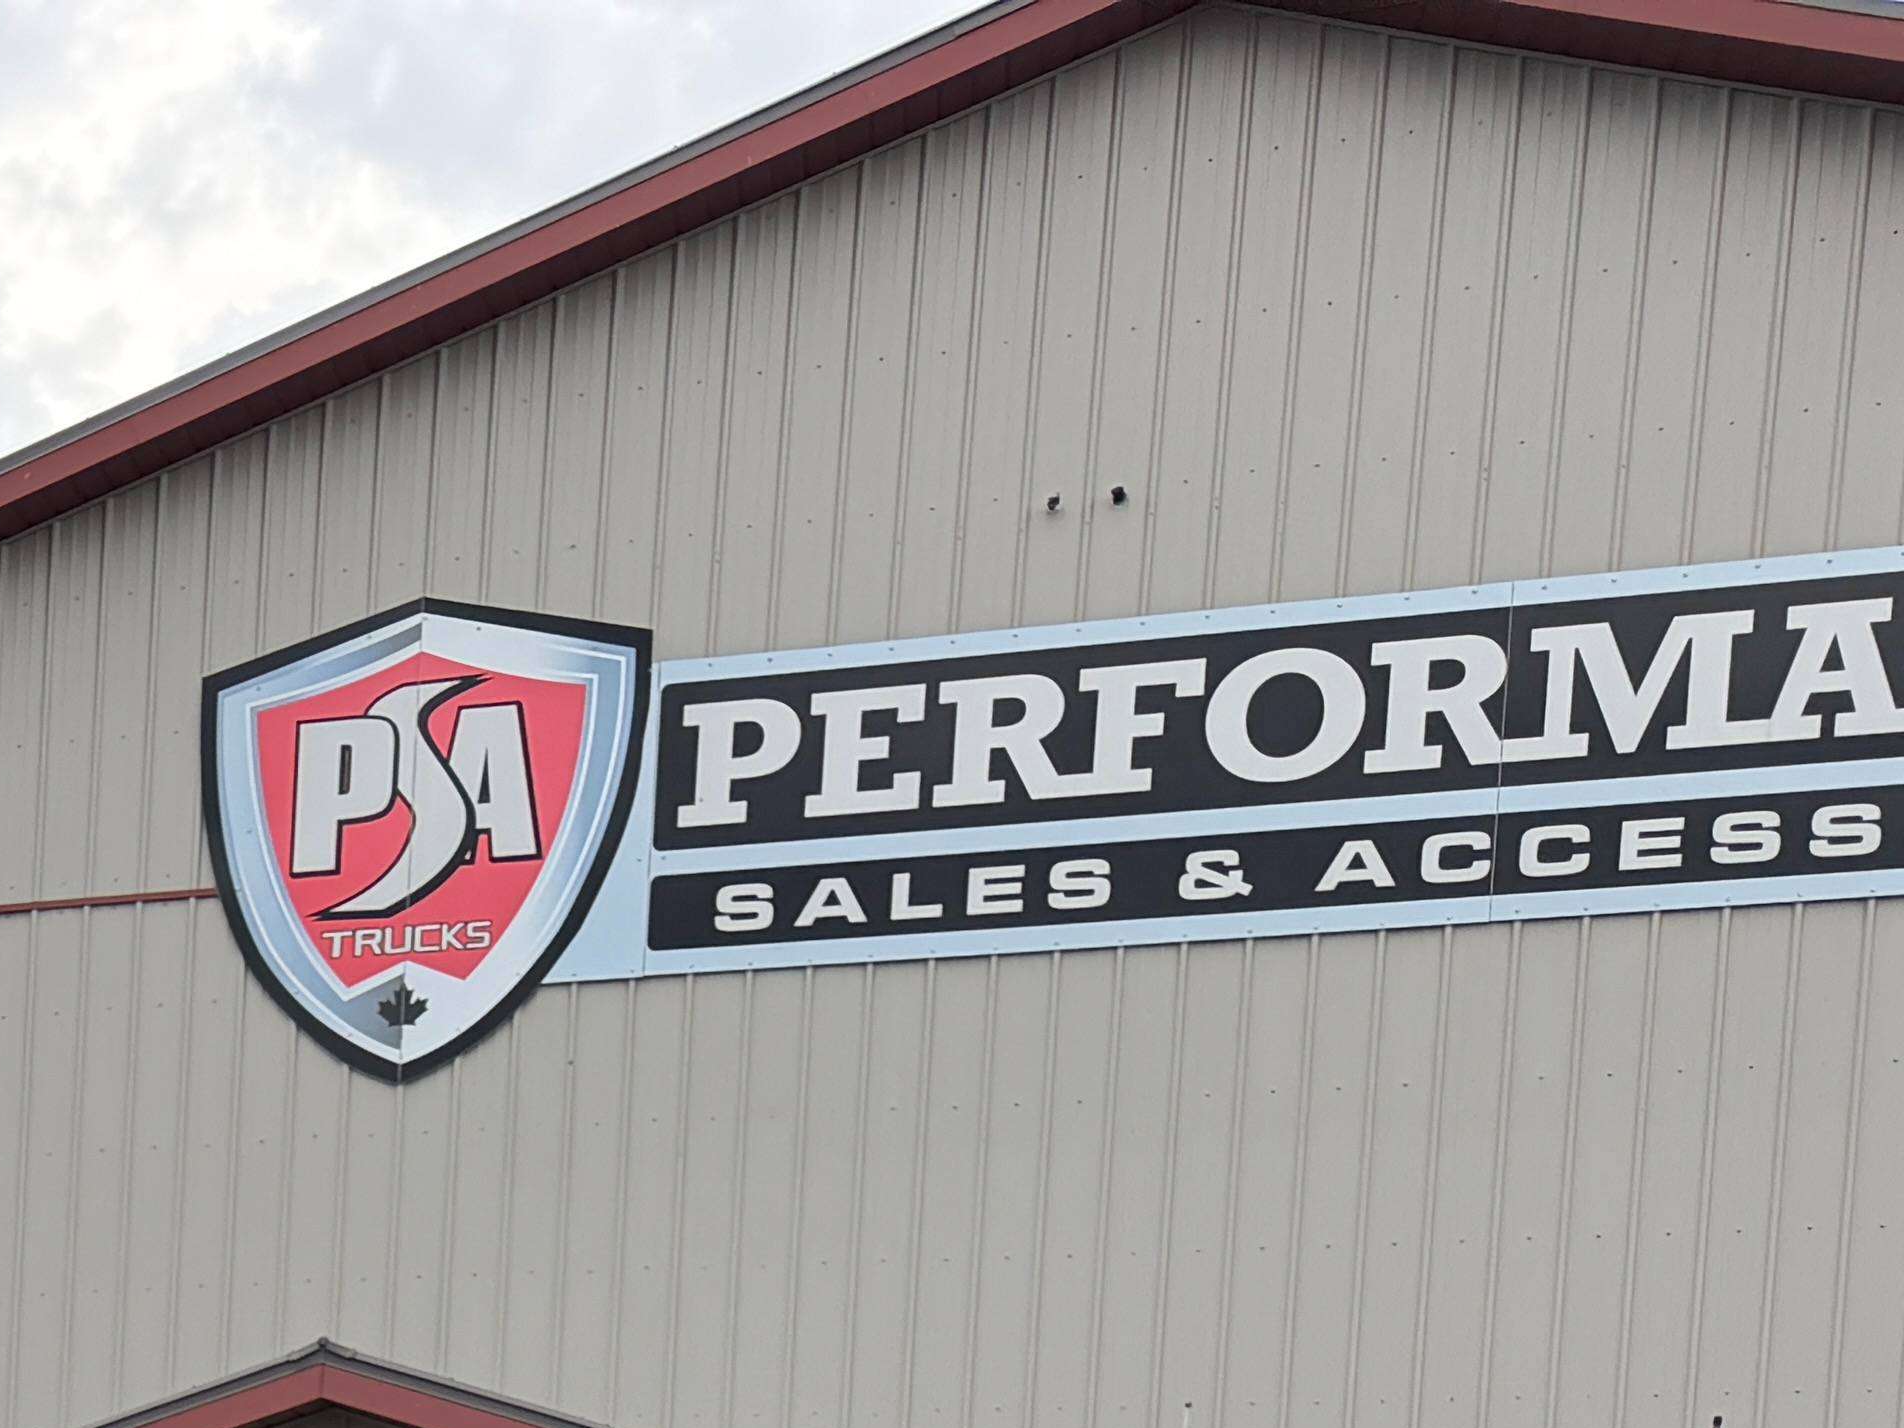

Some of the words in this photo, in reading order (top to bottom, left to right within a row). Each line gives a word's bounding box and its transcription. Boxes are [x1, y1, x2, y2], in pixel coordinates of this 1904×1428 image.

[289, 674, 542, 920] PSA
[677, 596, 1904, 828] PERFORMA
[321, 921, 493, 958] TRUCKS
[714, 858, 1111, 932] SALES
[1178, 849, 1252, 901] &
[1314, 803, 1883, 891] ACCESS
